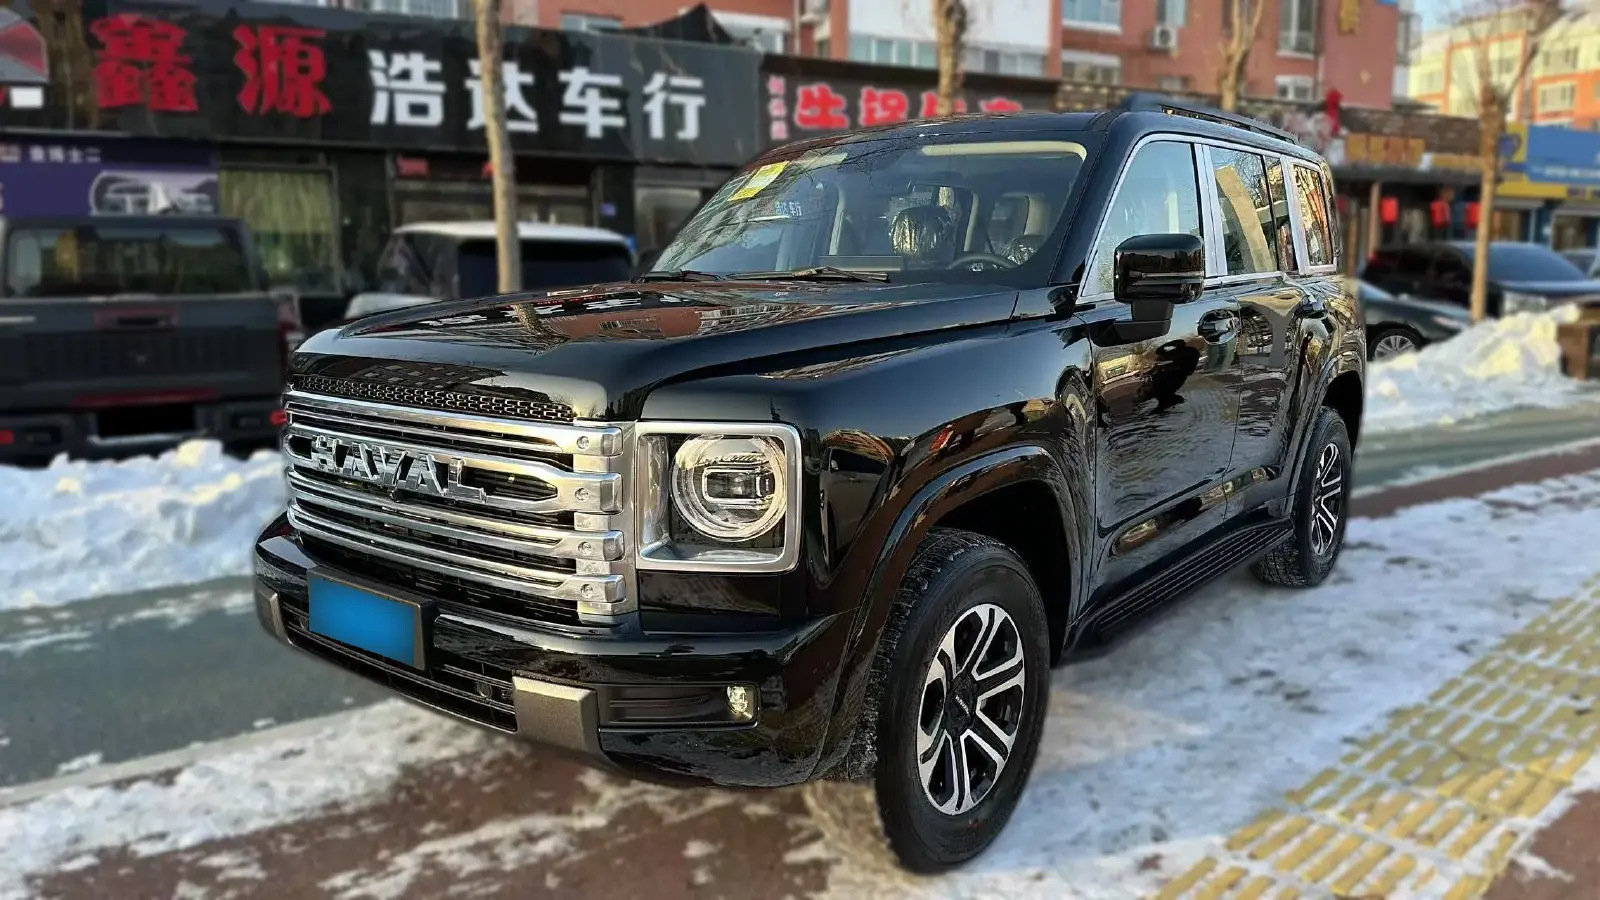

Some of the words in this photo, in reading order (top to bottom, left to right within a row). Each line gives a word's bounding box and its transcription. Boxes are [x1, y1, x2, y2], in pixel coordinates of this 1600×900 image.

[90, 12, 332, 118] 鑫源
[368, 49, 706, 140] 浩达车行
[312, 435, 487, 504] HAVAL
